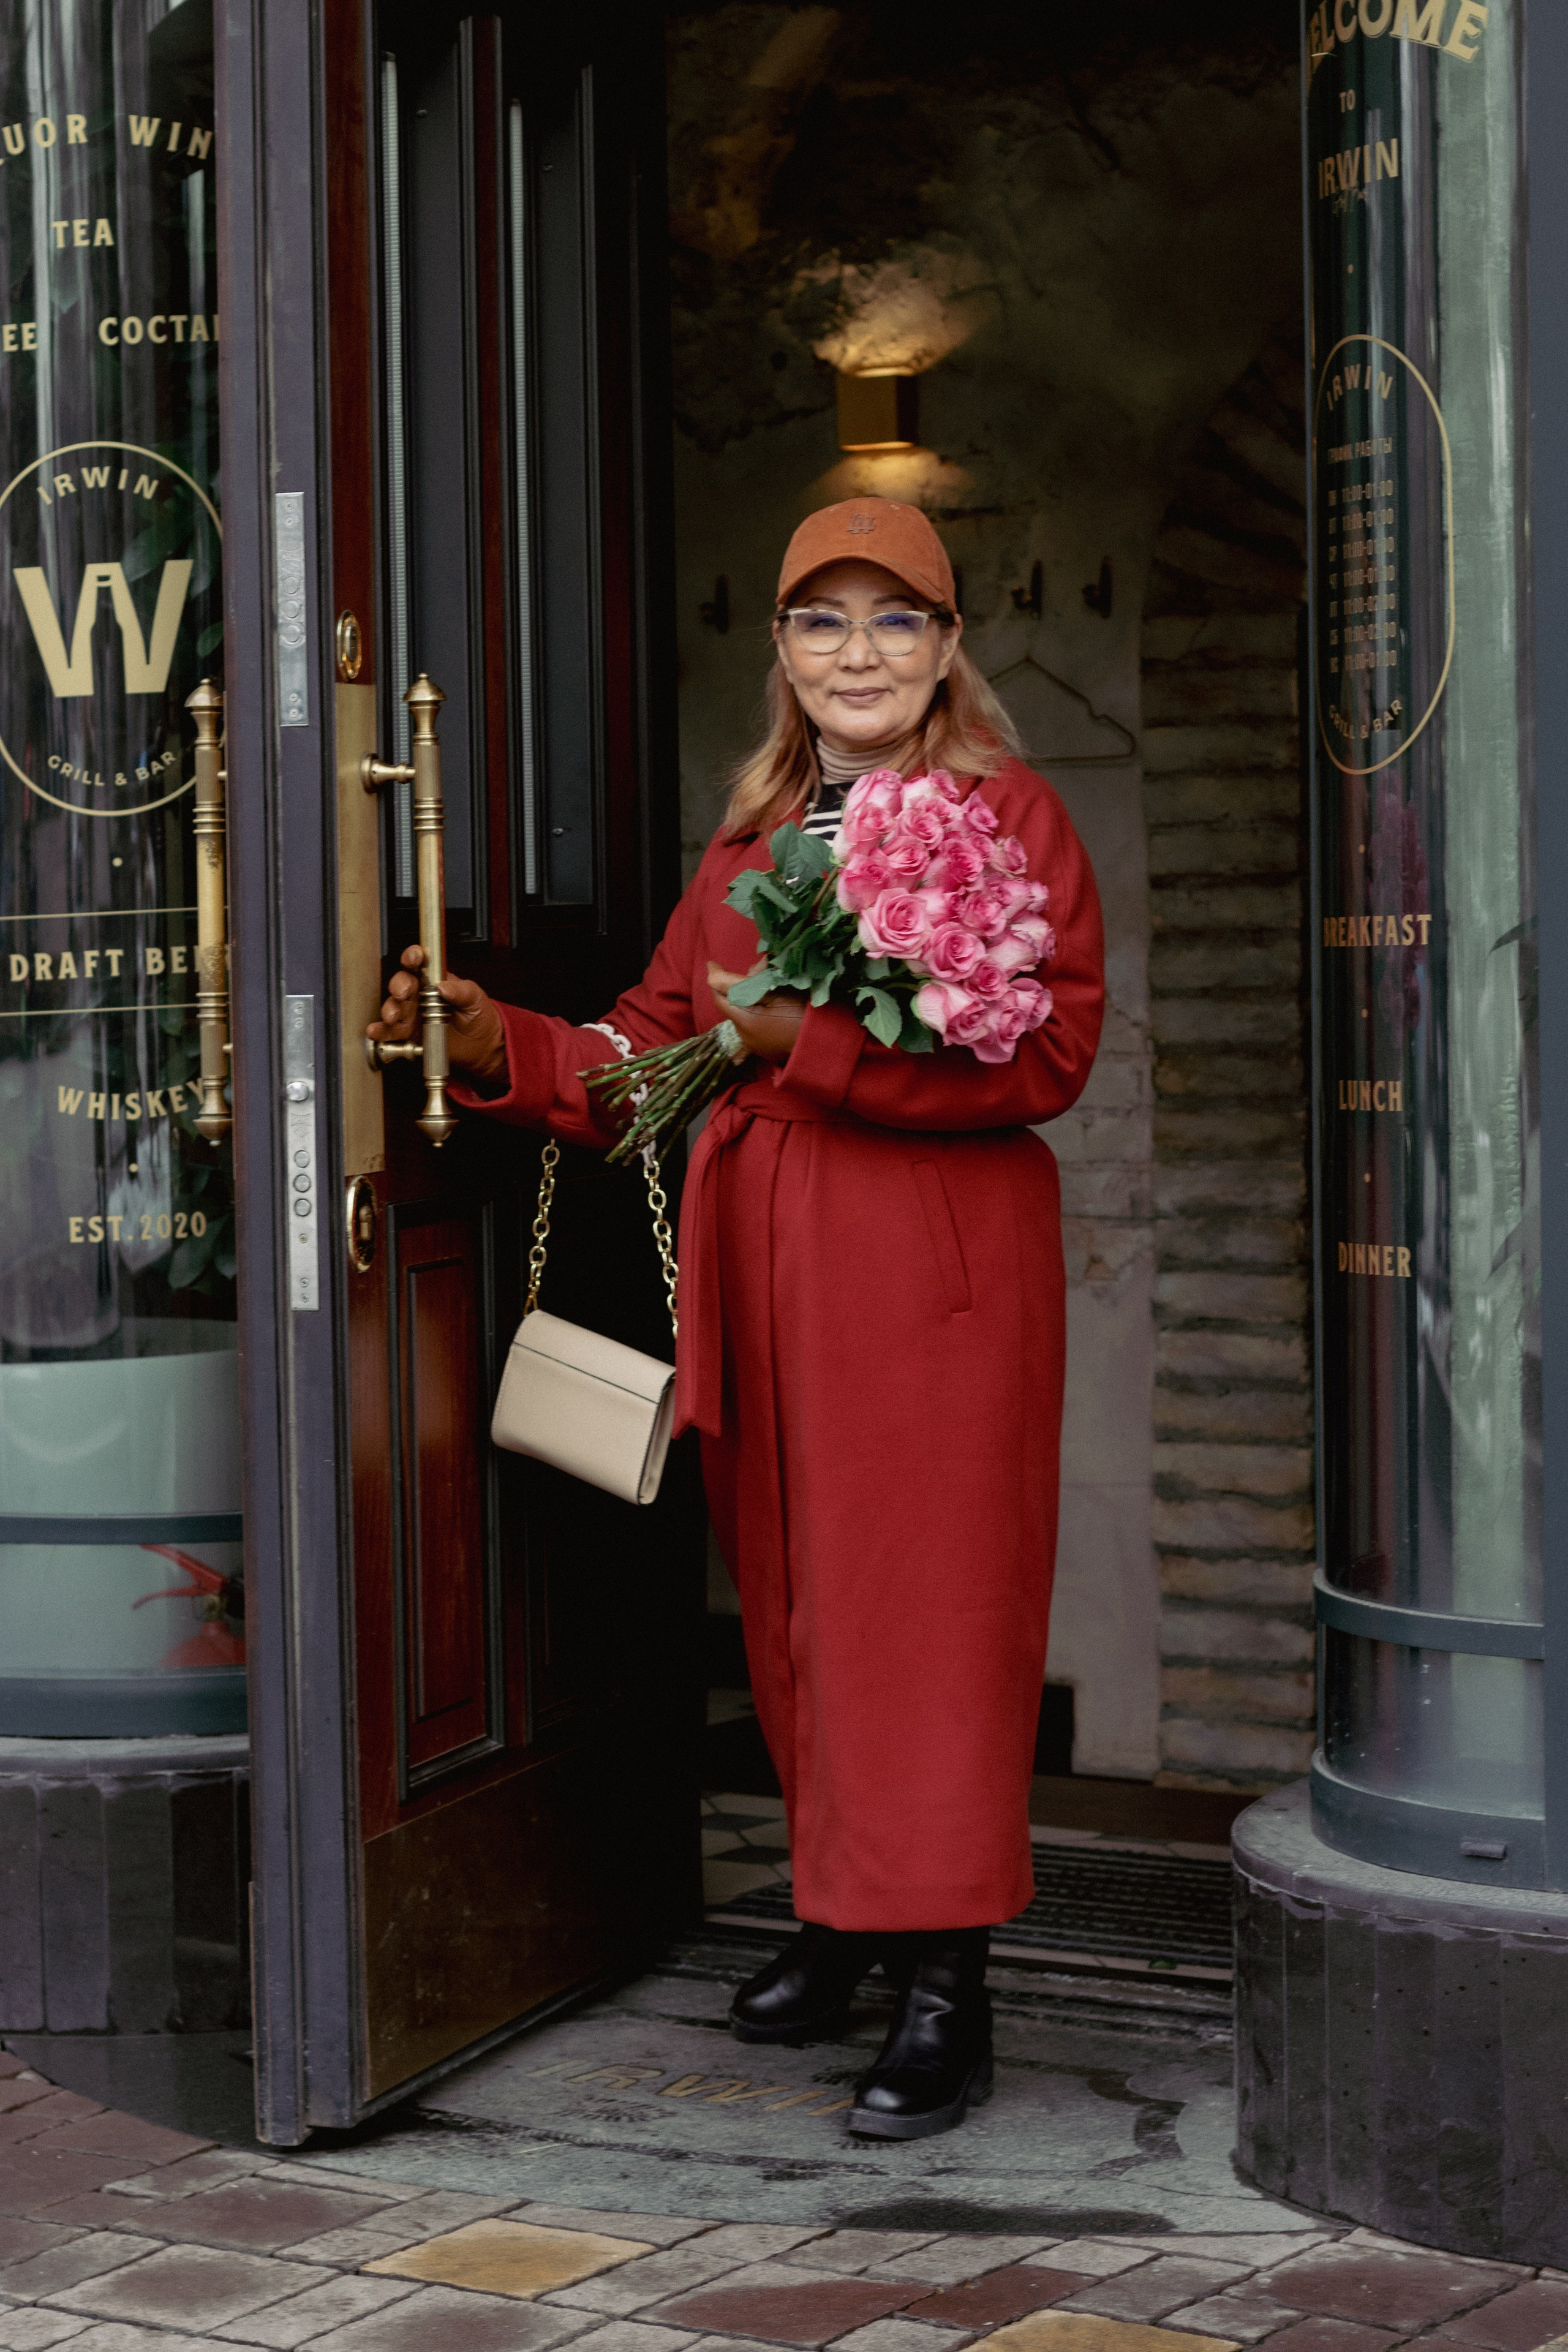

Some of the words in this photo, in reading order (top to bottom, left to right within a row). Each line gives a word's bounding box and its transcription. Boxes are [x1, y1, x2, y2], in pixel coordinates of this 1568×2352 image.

[1339, 89, 1356, 113] TO
[0, 114, 88, 165] UOR
[129, 115, 213, 159] WIN
[1318, 138, 1399, 200] IRWIN
[51, 217, 115, 248] TEA
[1326, 363, 1393, 411] IRWIN
[37, 466, 159, 506] IRWIN
[1372, 699, 1403, 733] BAR
[48, 755, 105, 786] GRILL
[115, 772, 127, 786] &
[135, 751, 176, 781] BAR
[9, 948, 124, 981] DRAFT
[57, 1077, 205, 1120] WHISKEY
[1338, 1080, 1403, 1112] LUNCH
[68, 1215, 134, 1244] EST.
[140, 1212, 208, 1241] 2020
[1338, 1242, 1412, 1278] DINNER
